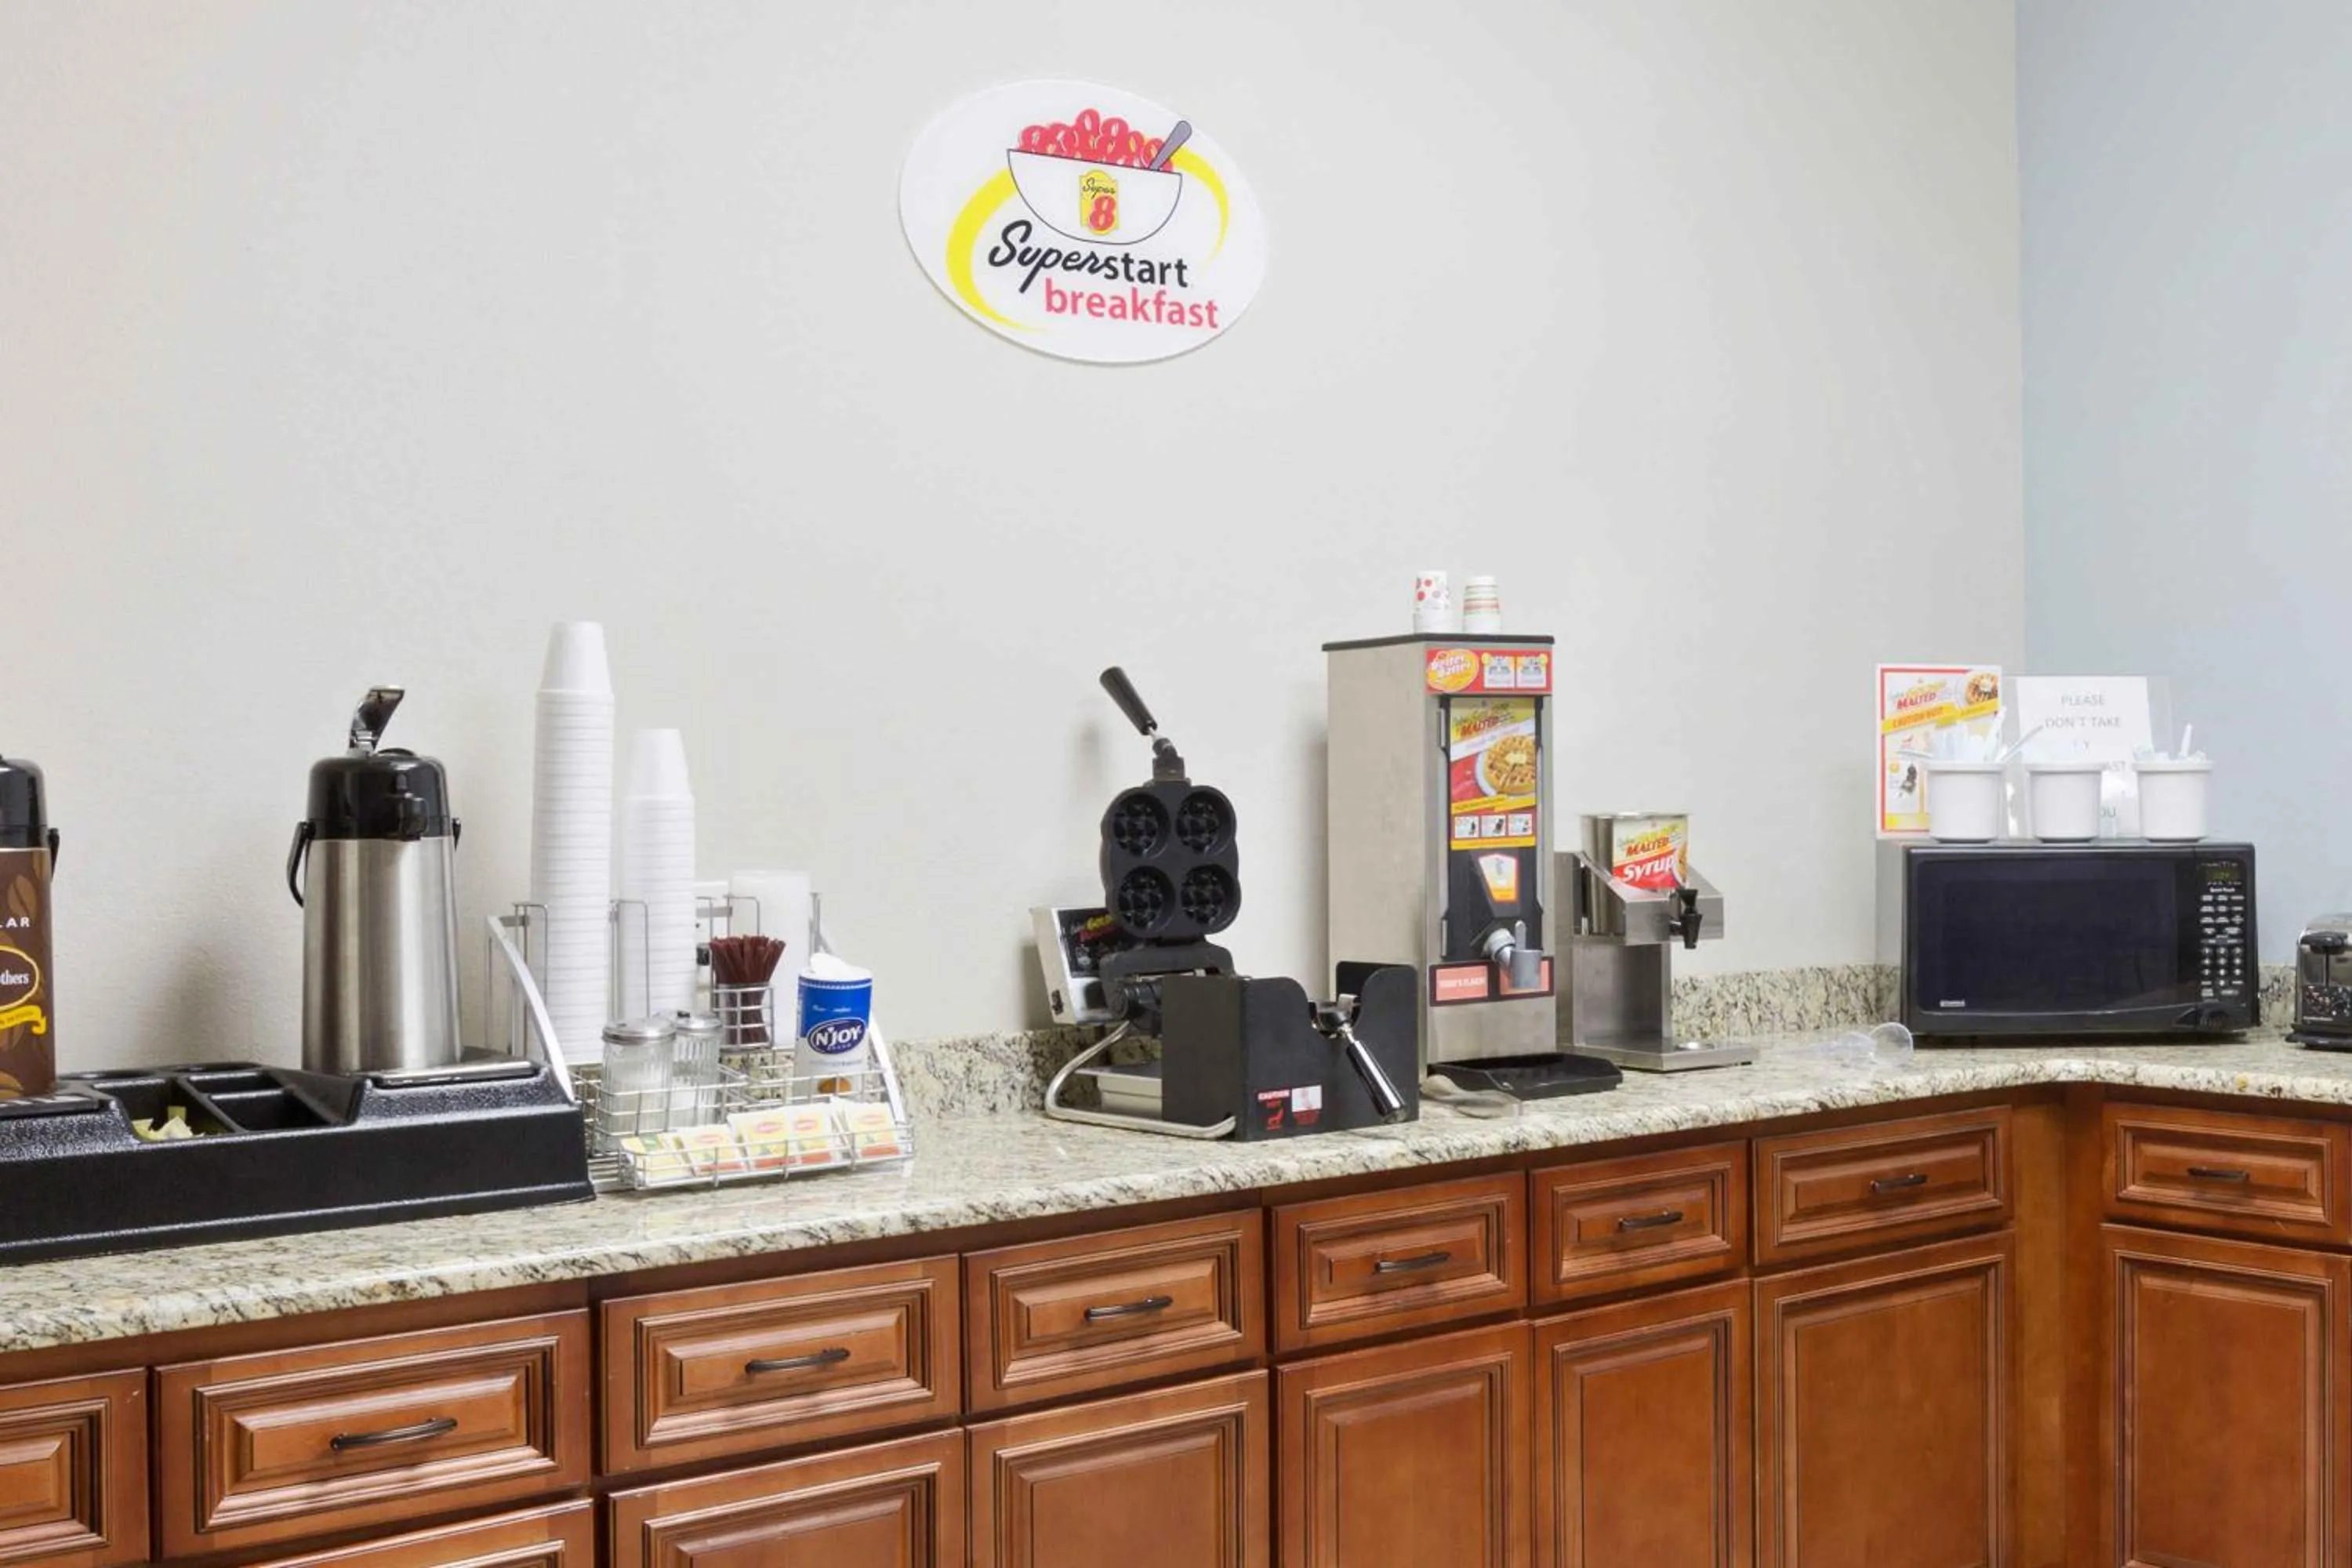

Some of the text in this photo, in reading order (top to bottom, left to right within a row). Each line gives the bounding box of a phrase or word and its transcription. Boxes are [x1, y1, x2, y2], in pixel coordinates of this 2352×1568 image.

[1089, 194, 1116, 231] 8
[988, 220, 1188, 294] Superstart
[1045, 277, 1218, 328] breakfast
[2061, 695, 2106, 706] PLEASE
[2092, 717, 2120, 728] TAKE
[0, 916, 31, 927] AR
[0, 969, 30, 985] thers
